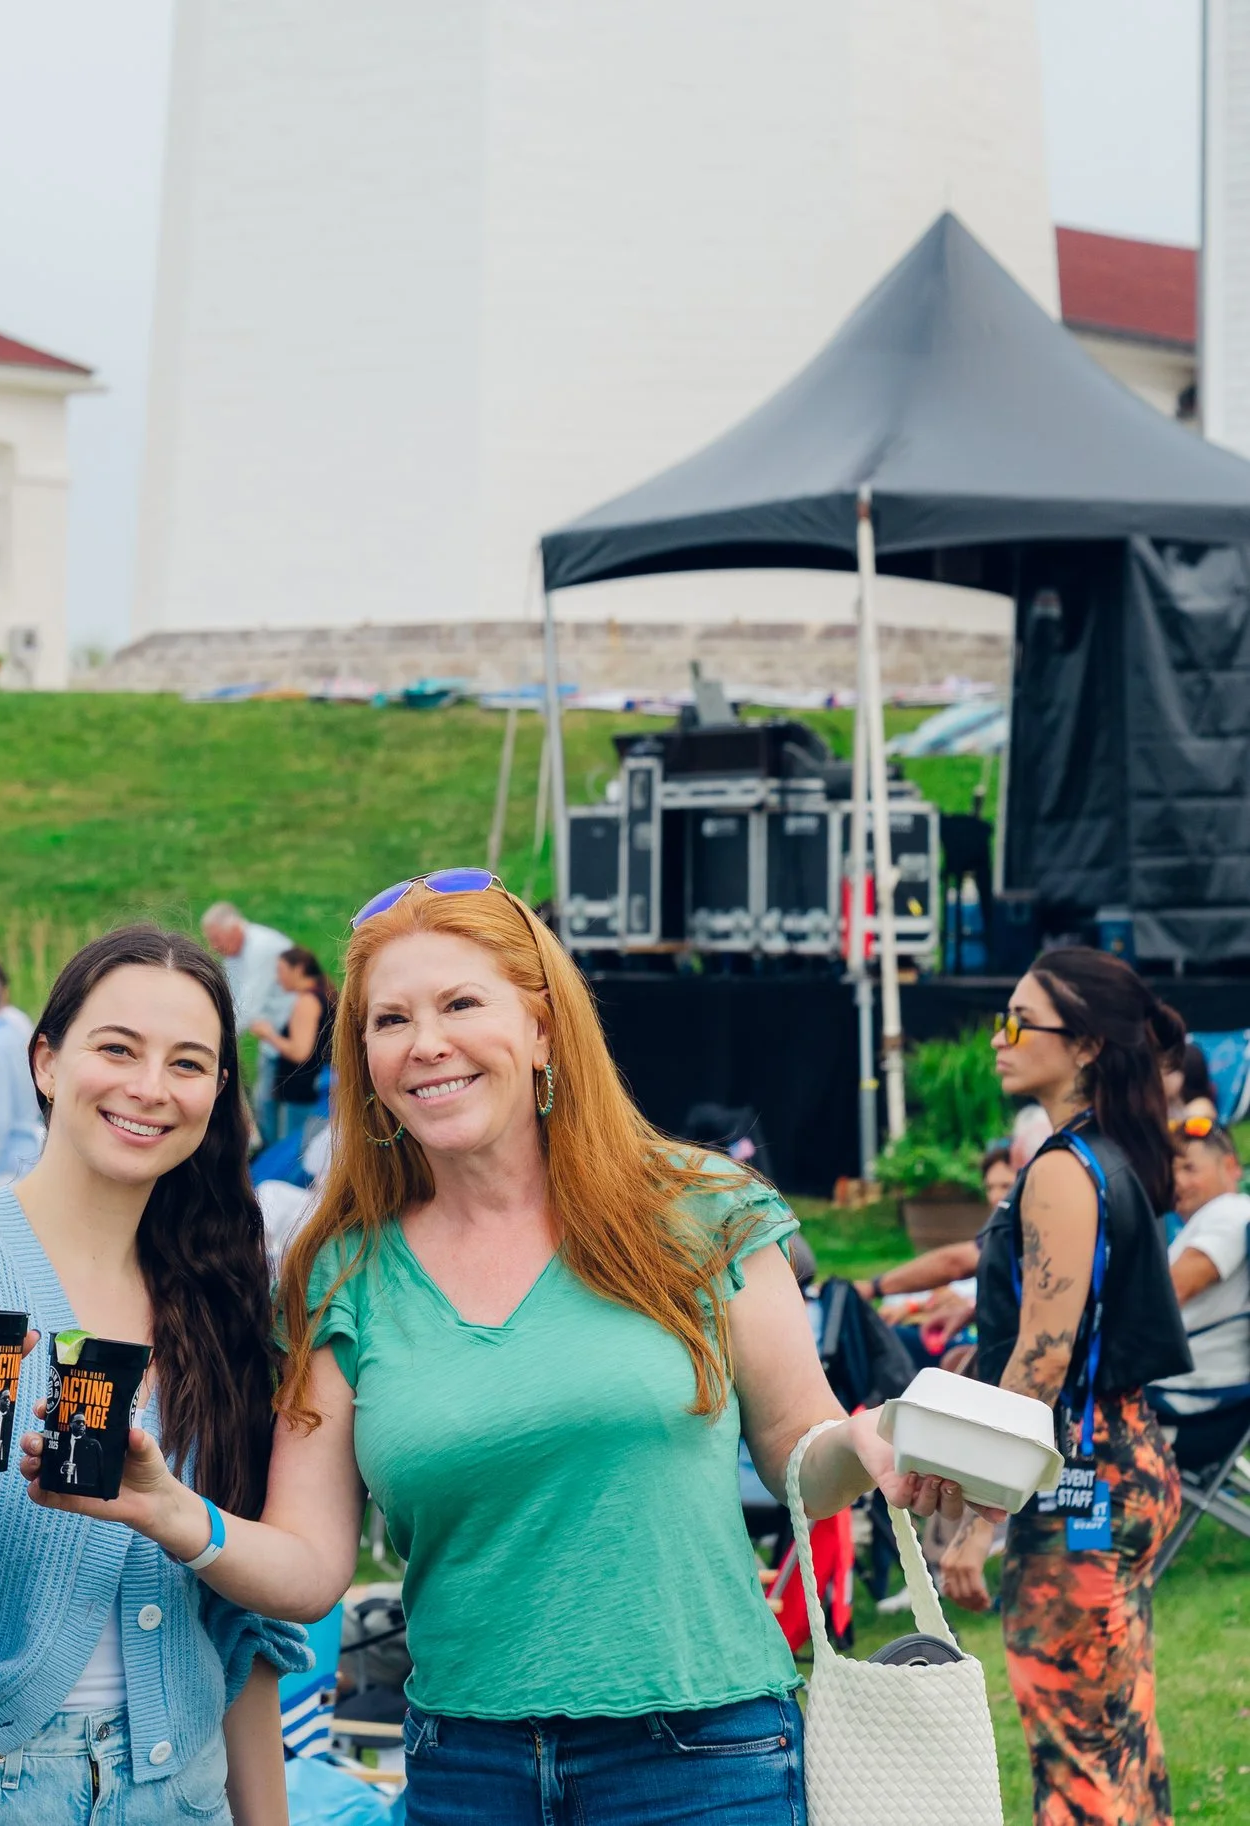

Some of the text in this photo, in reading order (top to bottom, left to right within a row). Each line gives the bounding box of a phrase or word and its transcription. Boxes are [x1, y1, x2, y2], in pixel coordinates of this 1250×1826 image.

[70, 1369, 87, 1378] KEVIN
[89, 1371, 105, 1381] HART
[61, 1376, 114, 1407] ACTING
[84, 1404, 110, 1430] AGE
[1059, 1467, 1096, 1488] EVENT
[1057, 1487, 1094, 1509] STAFF
